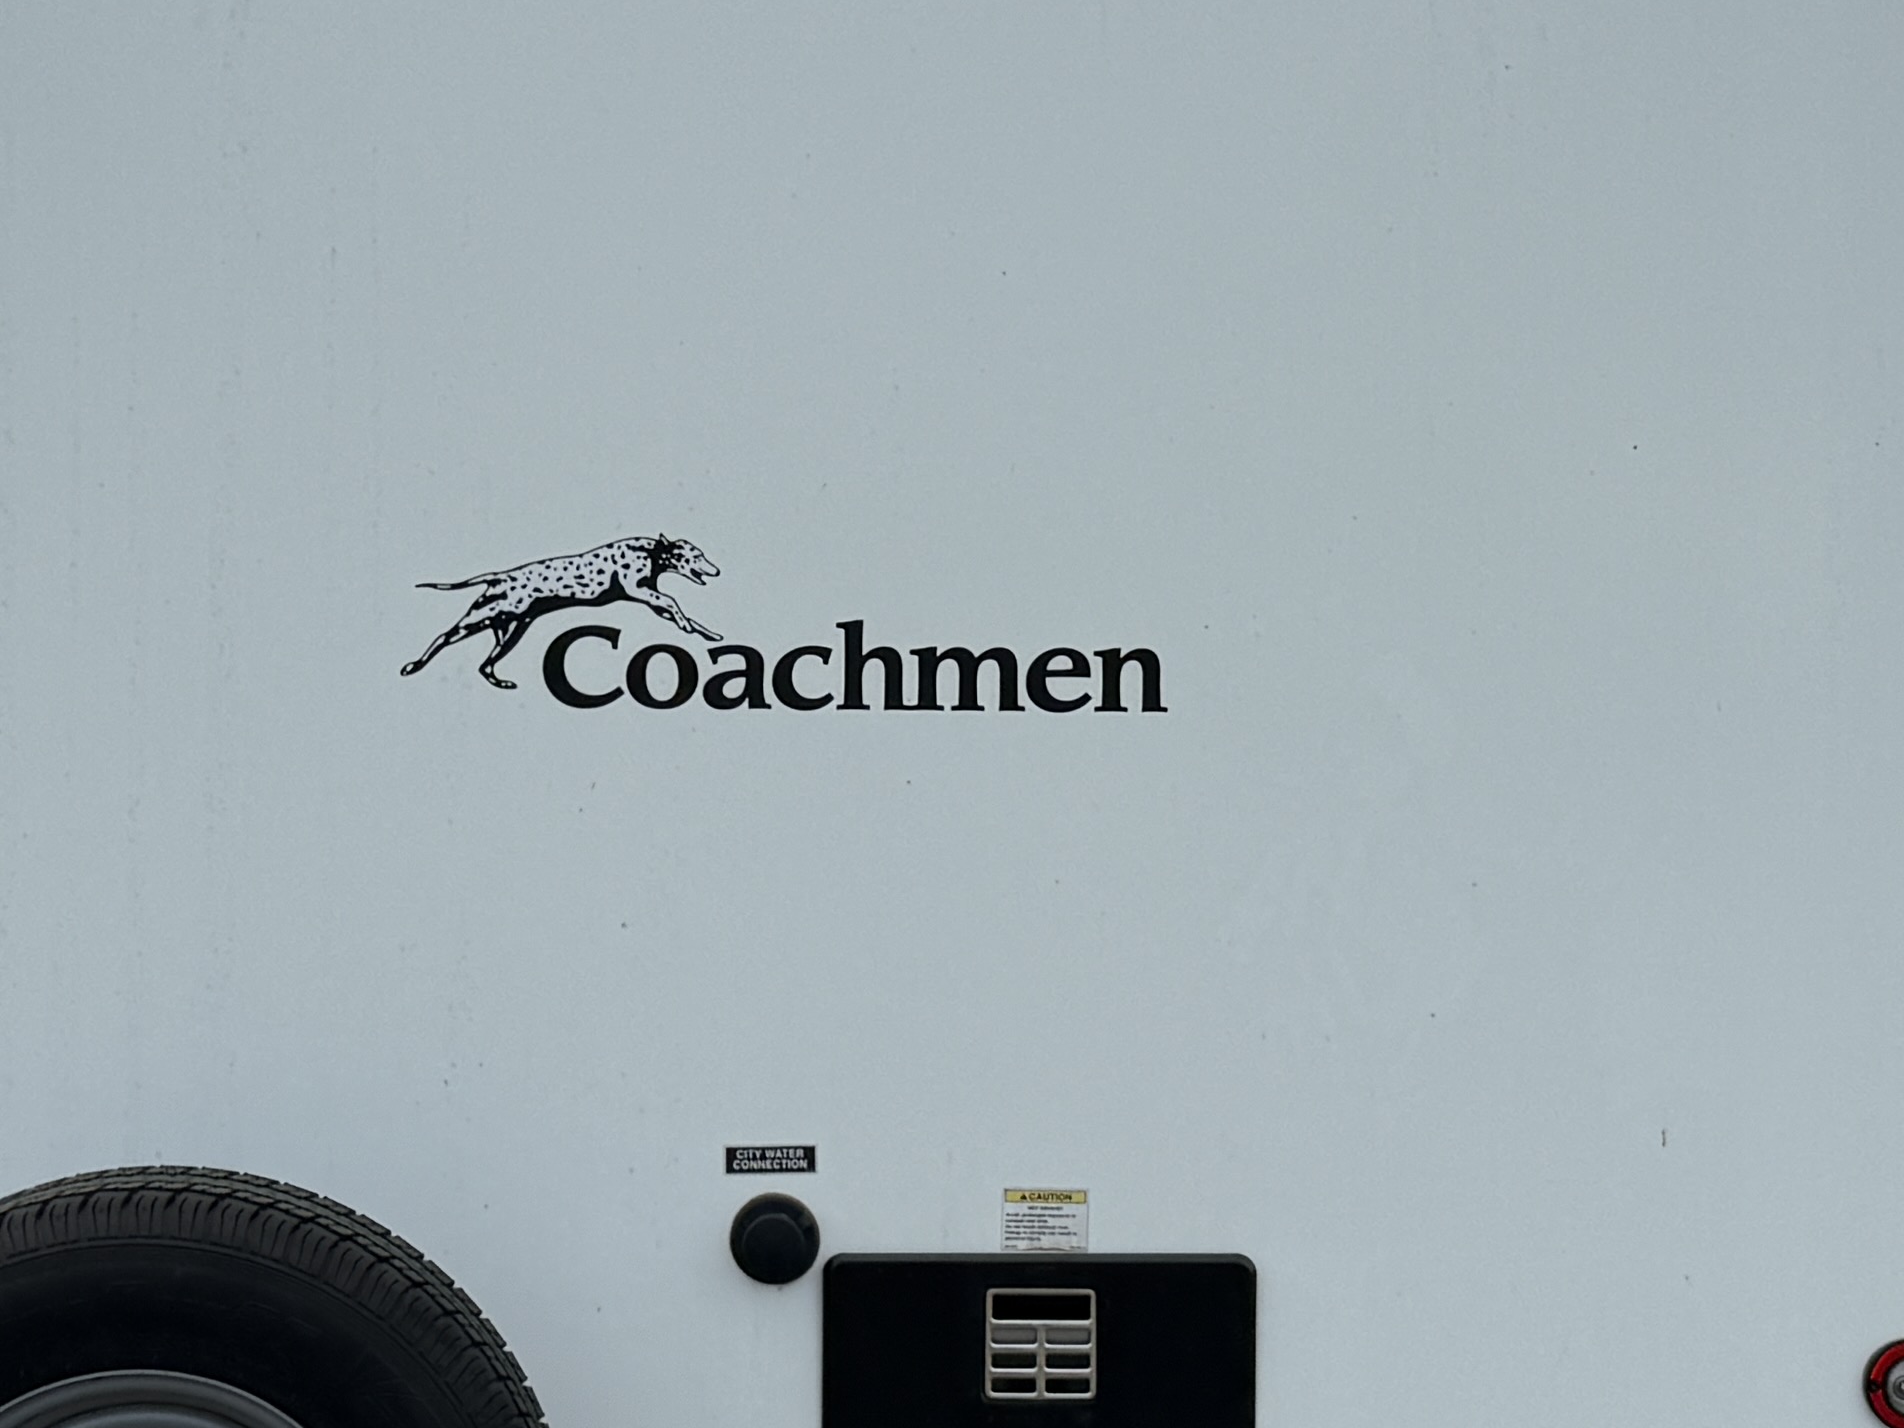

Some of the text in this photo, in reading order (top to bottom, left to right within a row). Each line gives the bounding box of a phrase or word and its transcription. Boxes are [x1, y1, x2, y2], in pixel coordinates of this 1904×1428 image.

[542, 619, 1169, 714] Coachmen
[736, 1148, 804, 1159] CITY WATER
[733, 1159, 808, 1170] CONNECTION
[1029, 1193, 1072, 1202] CAUTION
